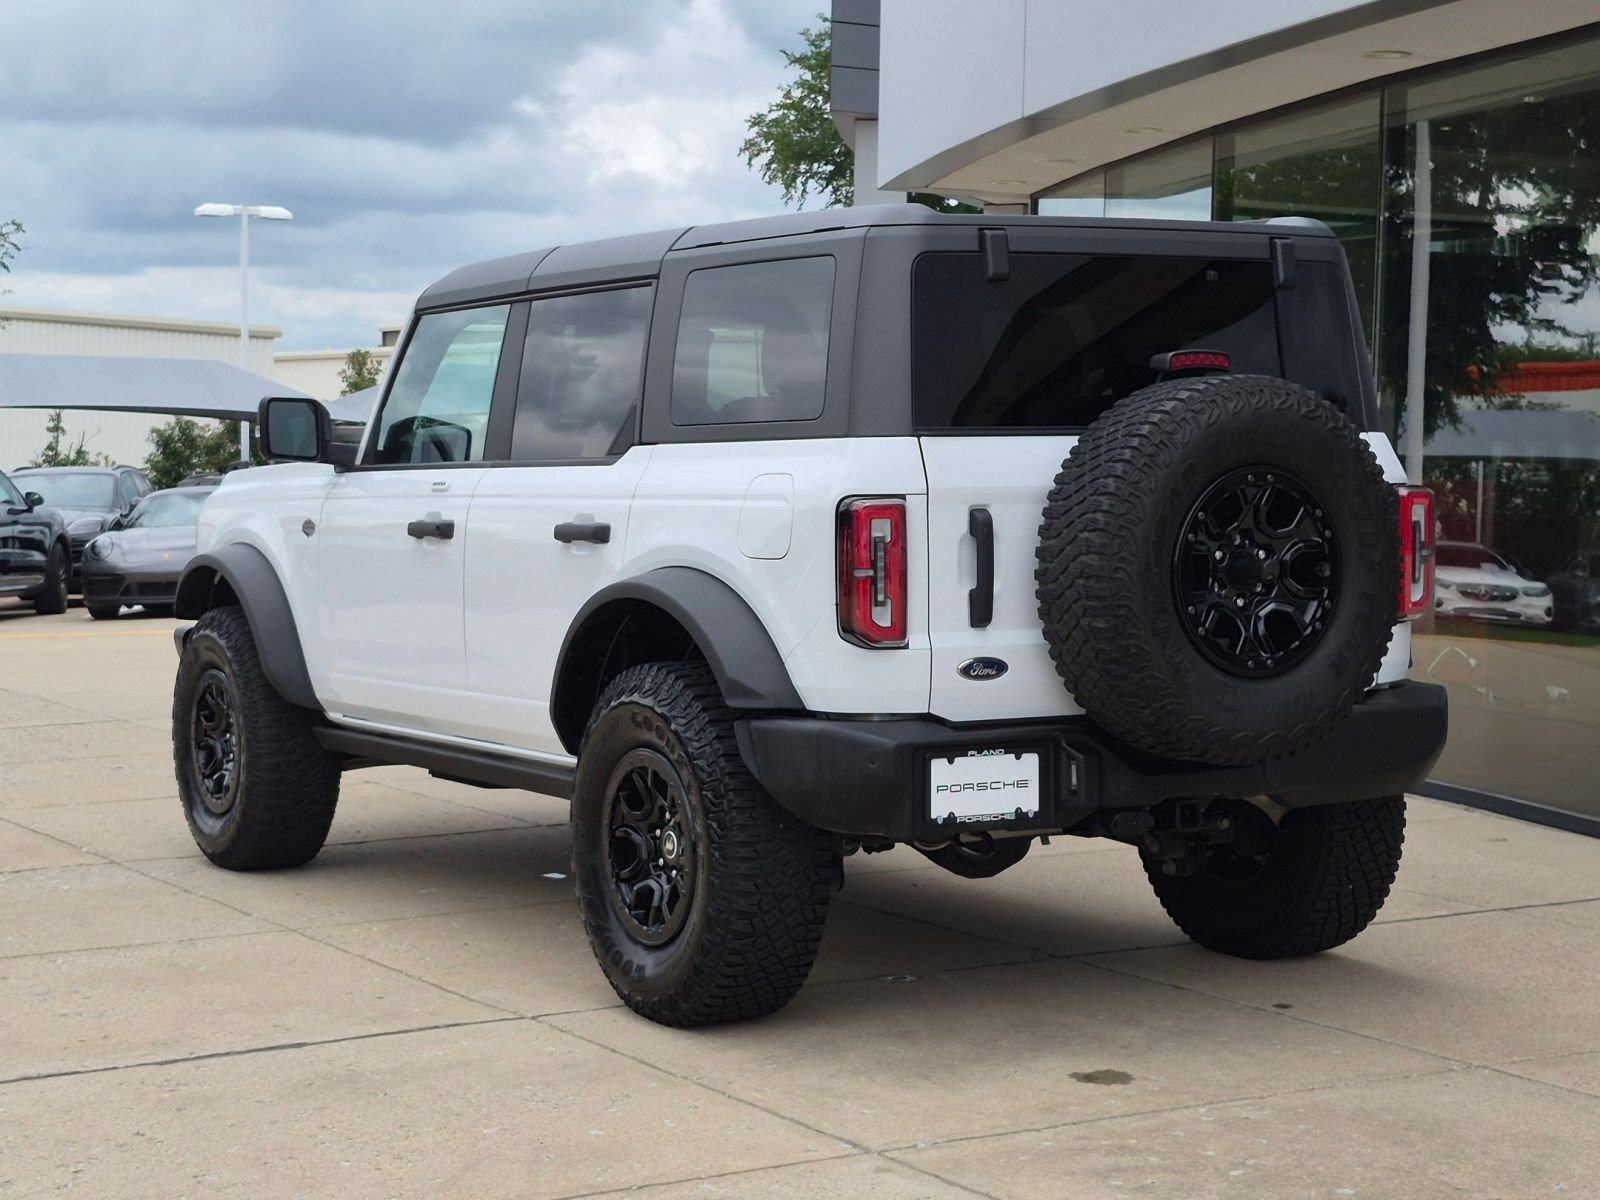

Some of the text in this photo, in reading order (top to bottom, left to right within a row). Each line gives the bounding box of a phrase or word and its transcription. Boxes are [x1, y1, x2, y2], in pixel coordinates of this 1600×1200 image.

[970, 662, 998, 676] Ford
[968, 748, 1005, 758] PLANO
[937, 779, 1029, 793] PORSCHE
[957, 812, 1015, 823] PORSCHE
